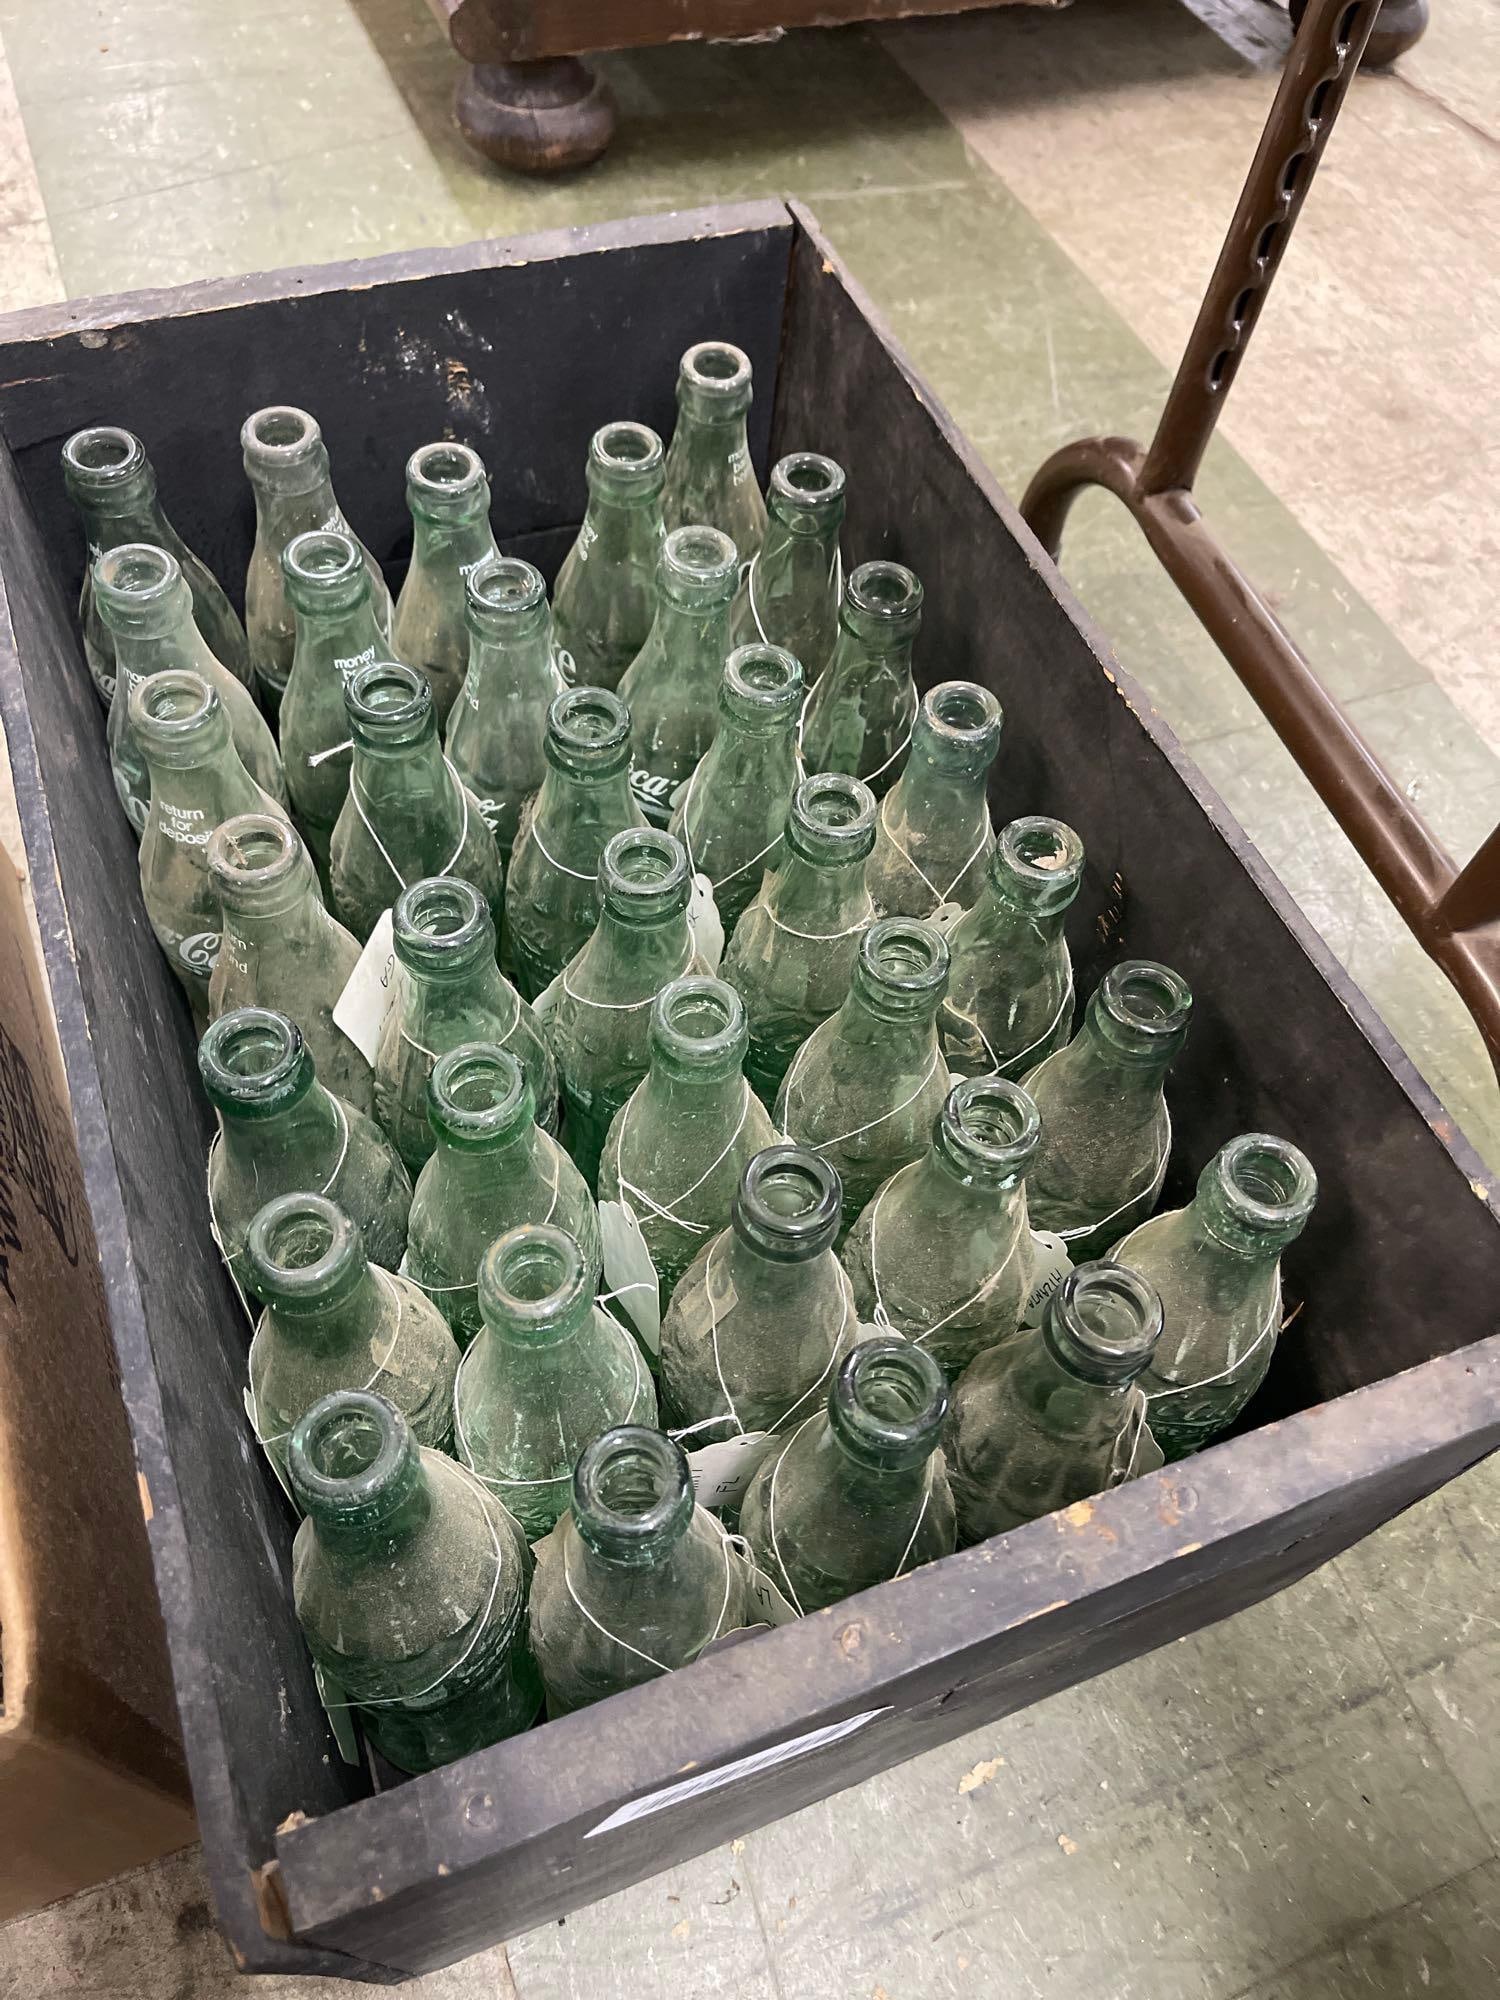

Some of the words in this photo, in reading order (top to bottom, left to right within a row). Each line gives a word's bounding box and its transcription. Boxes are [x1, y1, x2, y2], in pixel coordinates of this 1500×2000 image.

[333, 645, 376, 669] money
[160, 801, 205, 820] return
[170, 816, 193, 831] for
